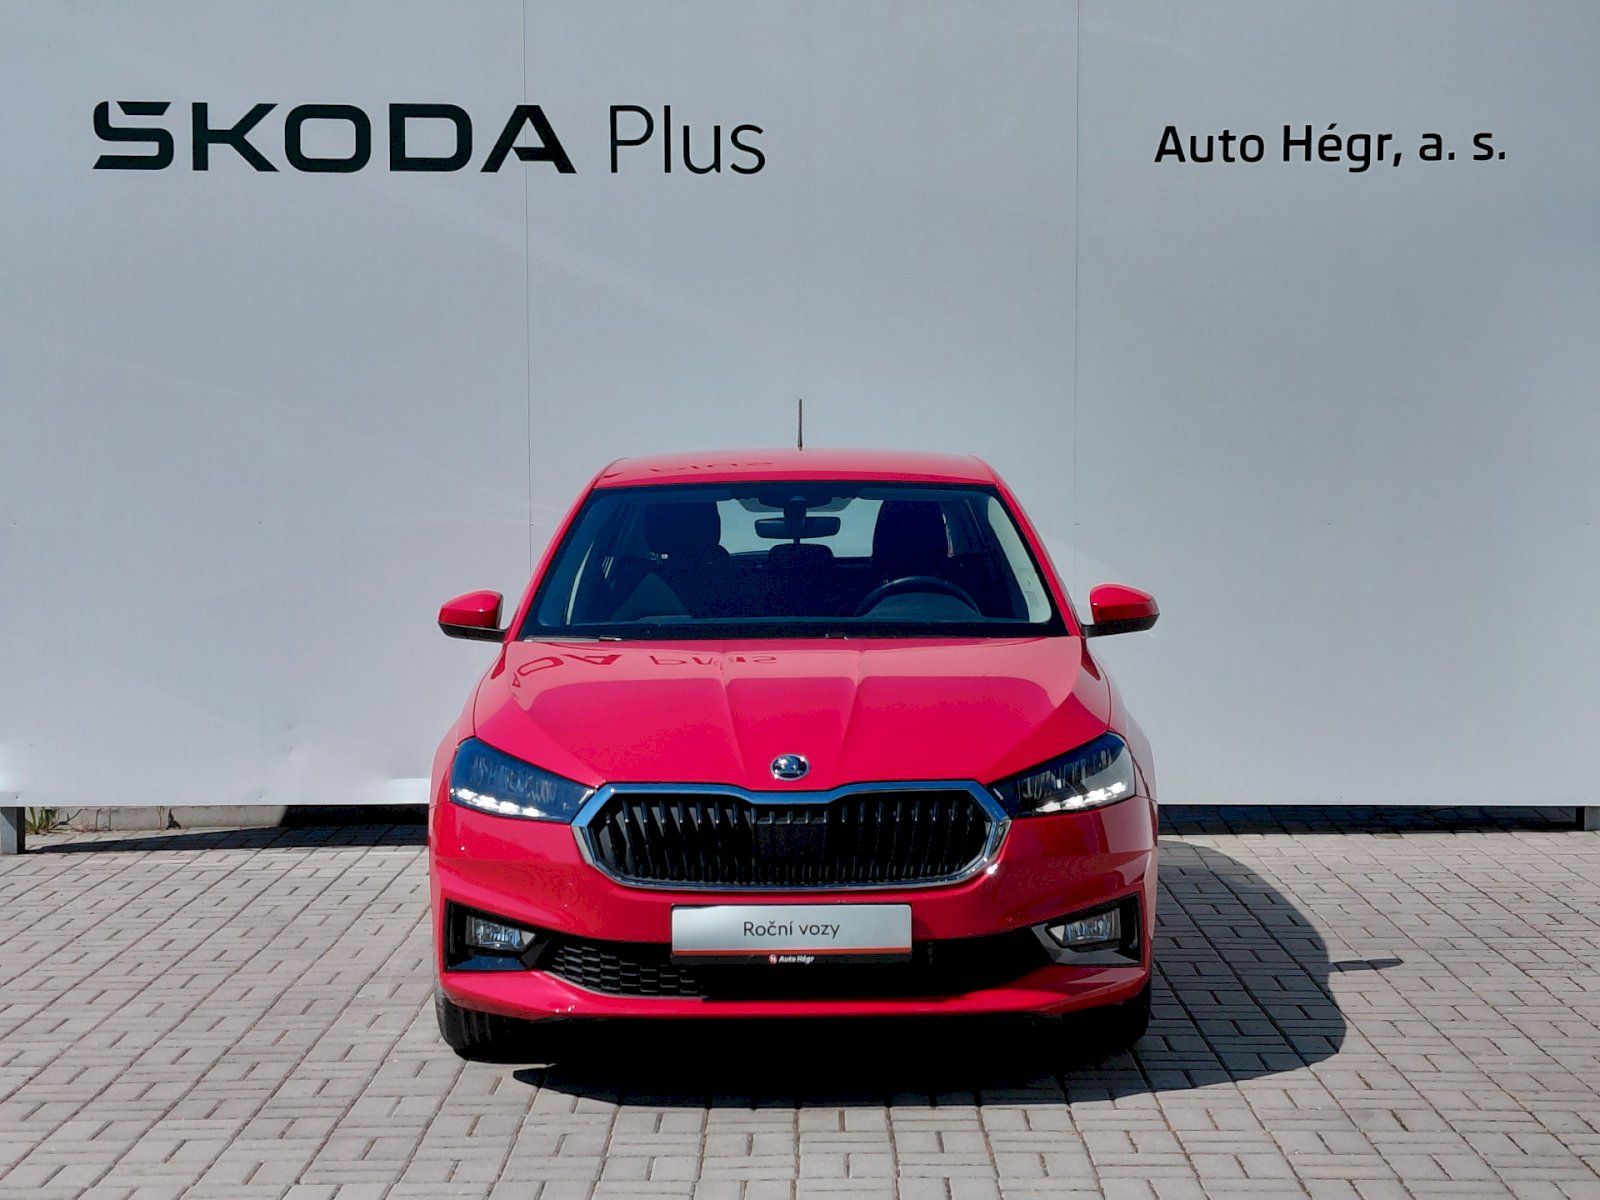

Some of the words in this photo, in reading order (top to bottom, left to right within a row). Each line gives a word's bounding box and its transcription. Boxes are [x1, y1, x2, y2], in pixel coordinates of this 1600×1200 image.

[609, 104, 766, 175] Plus
[1153, 125, 1265, 163] Auto
[1282, 122, 1403, 173] Hégr,
[1418, 132, 1456, 161] a.
[1472, 132, 1506, 161] s.
[743, 920, 794, 937] Roční
[799, 923, 841, 939] vozy
[778, 955, 797, 963] Auto
